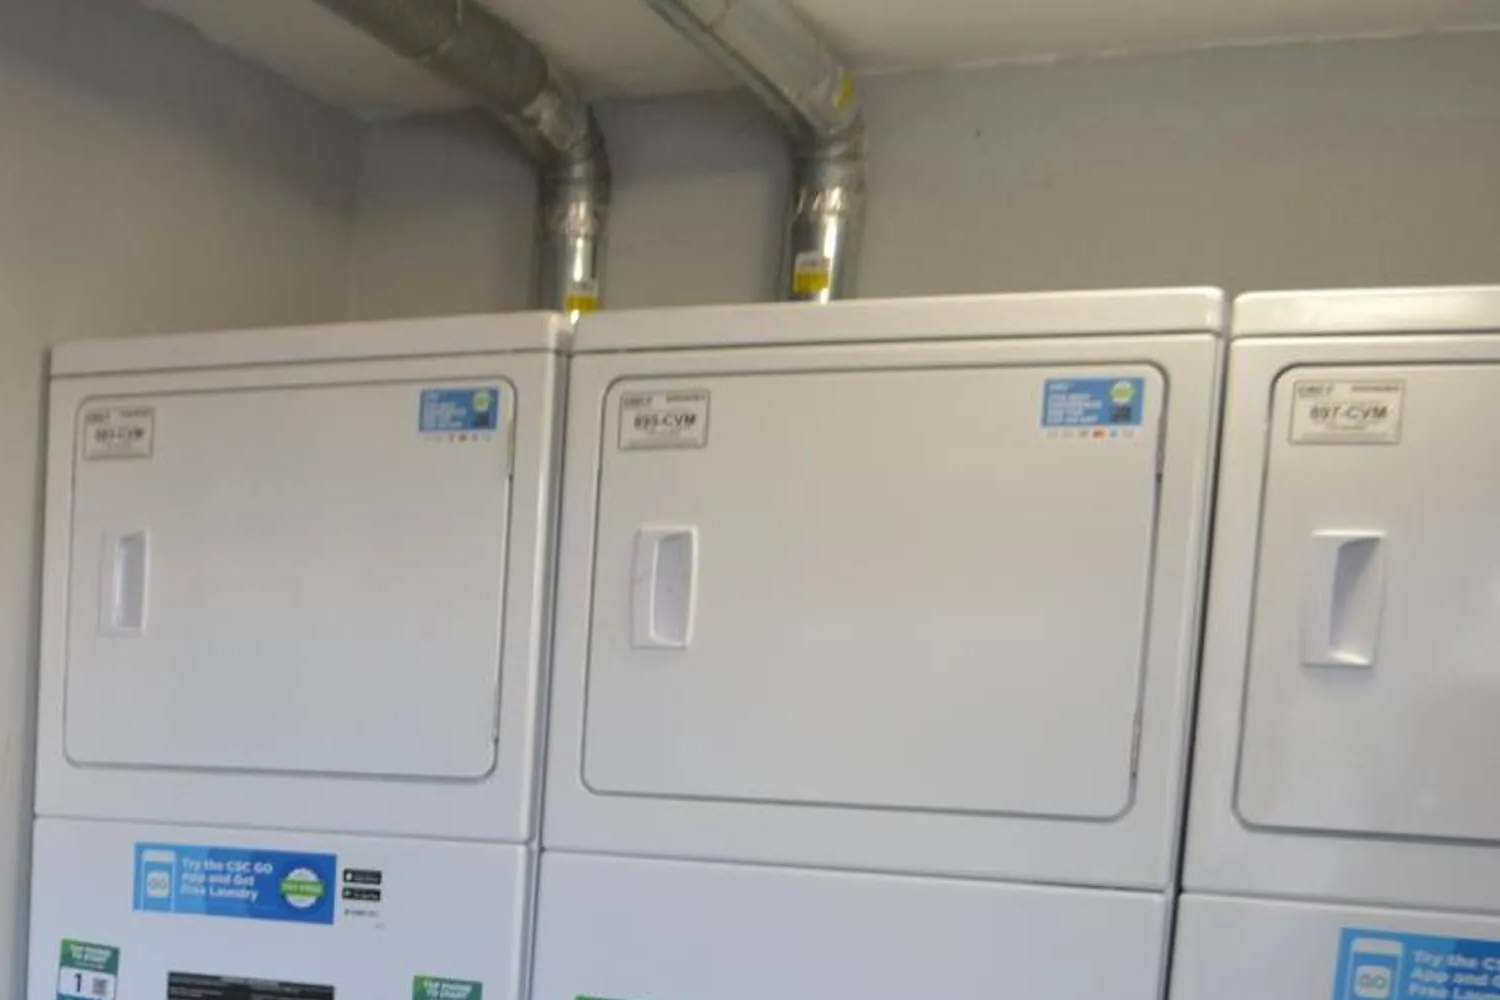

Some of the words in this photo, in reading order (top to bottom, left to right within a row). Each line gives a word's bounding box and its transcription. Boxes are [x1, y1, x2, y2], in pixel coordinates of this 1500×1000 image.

[182, 858, 201, 872] Try
[203, 860, 225, 873] the
[226, 862, 251, 873] CSC
[253, 863, 273, 874] GO
[181, 873, 205, 886] App
[208, 874, 232, 886] and
[233, 875, 255, 887] Get
[181, 885, 206, 898] Free
[209, 886, 260, 902] Laundry
[1414, 949, 1444, 968] Try
[1447, 954, 1479, 968] the
[74, 972, 82, 993] 1
[1411, 968, 1448, 984] App
[1452, 972, 1488, 988] and
[1409, 983, 1448, 998] Free
